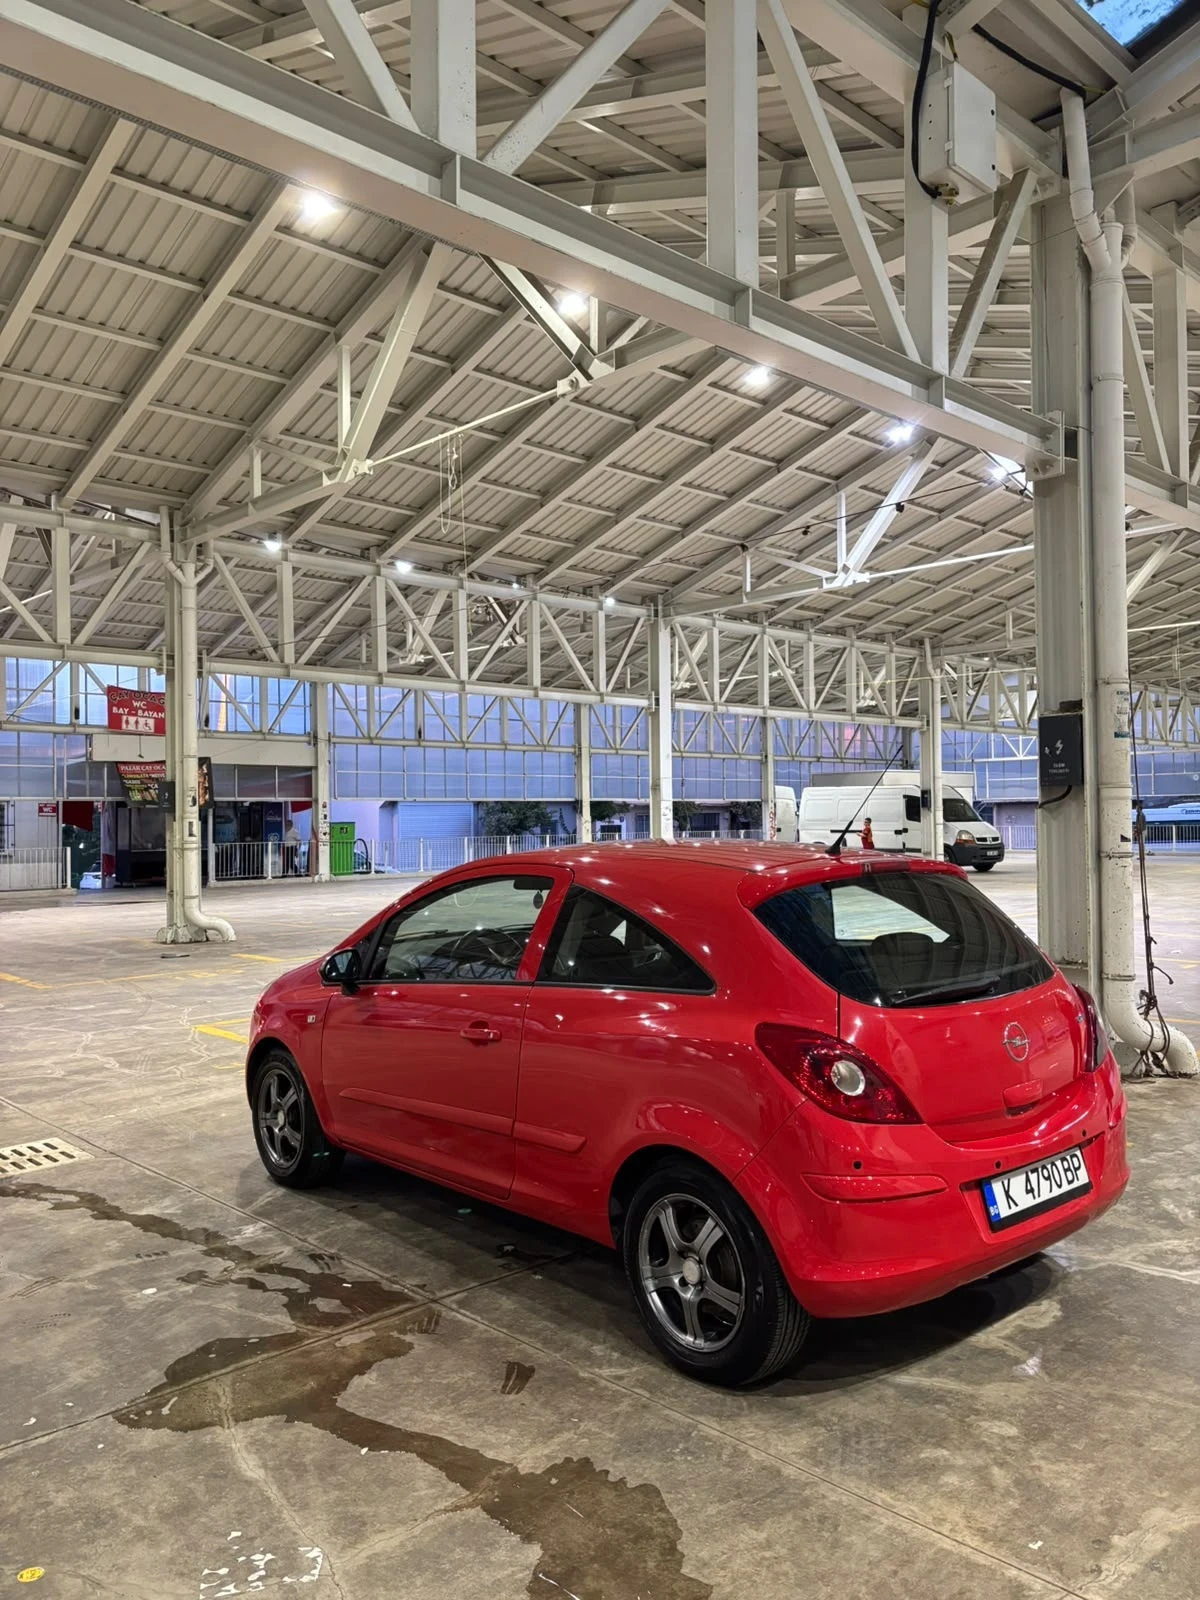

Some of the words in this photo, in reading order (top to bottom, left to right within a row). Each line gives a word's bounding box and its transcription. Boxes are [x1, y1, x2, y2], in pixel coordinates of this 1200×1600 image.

[132, 700, 147, 709] WC
[112, 706, 129, 715] BAY
[137, 709, 165, 719] BAYAN
[1001, 1178, 1019, 1210] K
[1025, 1161, 1063, 1201] 4790
[1060, 1153, 1082, 1186] BP
[989, 1205, 999, 1217] BG
